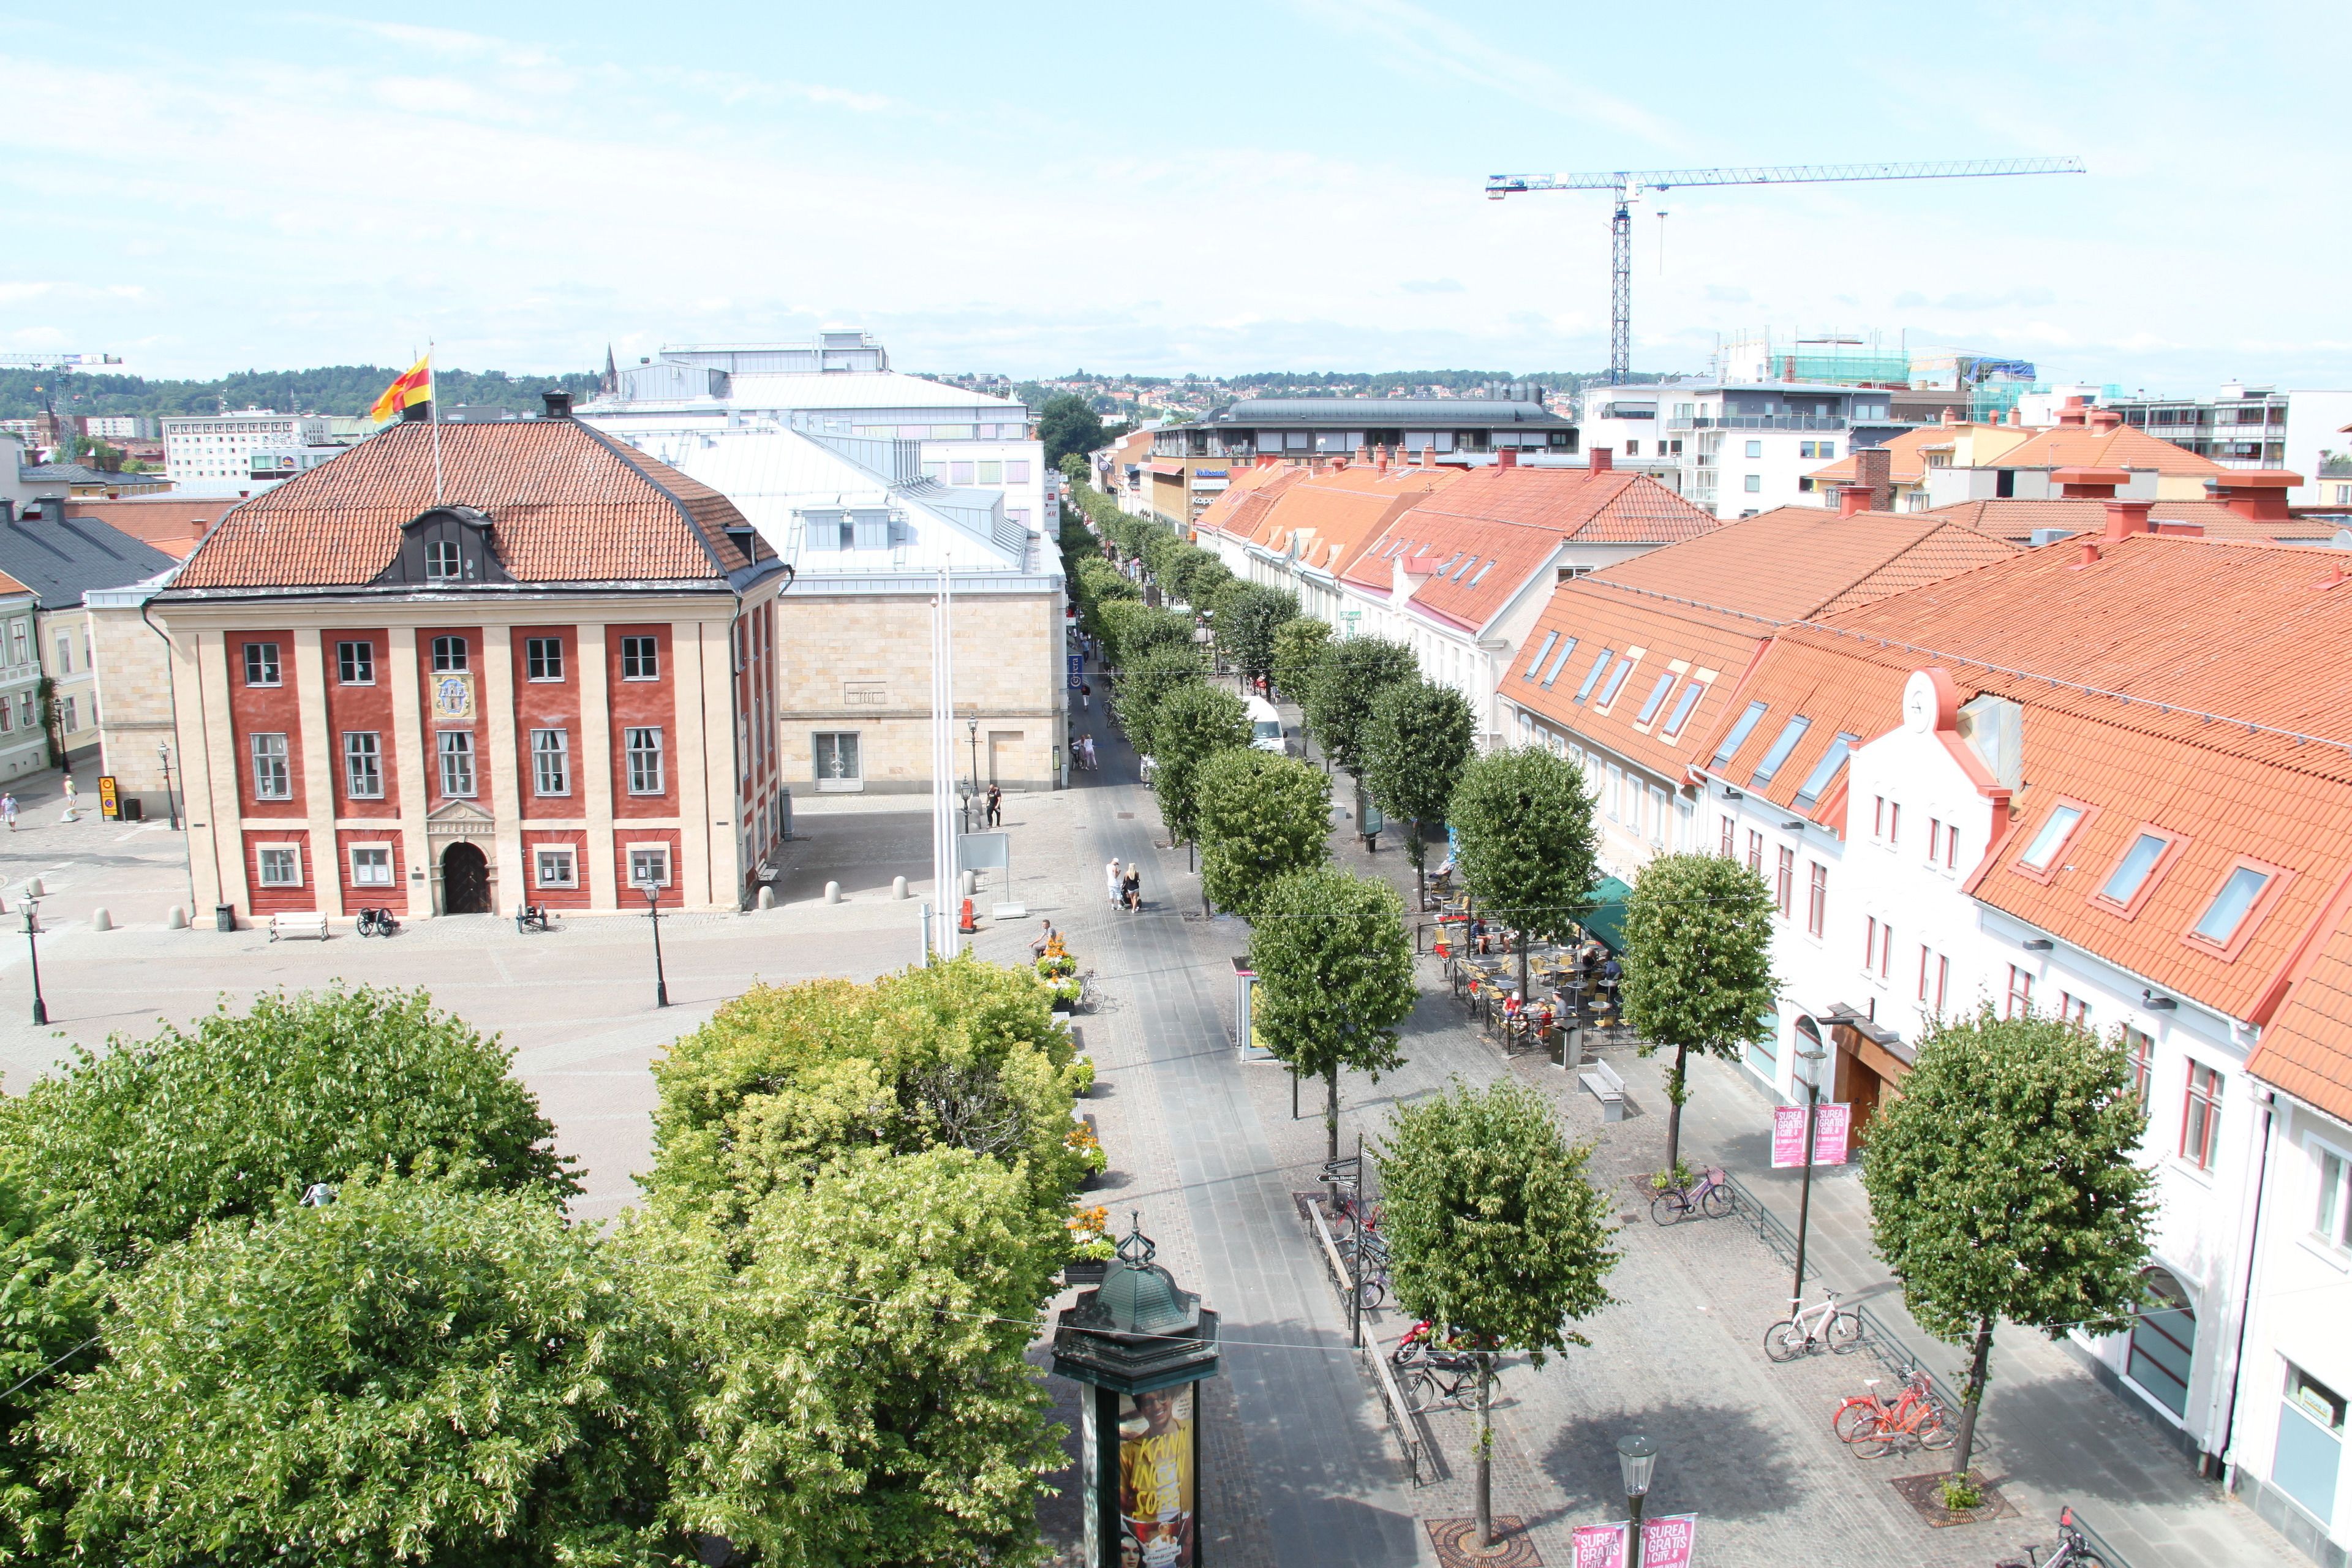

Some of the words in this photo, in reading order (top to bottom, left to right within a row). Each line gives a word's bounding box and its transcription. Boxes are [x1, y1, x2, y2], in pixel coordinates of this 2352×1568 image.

[1192, 496, 1215, 505] Kapp
[1777, 1120, 1803, 1129] GRATIS
[1819, 1118, 1844, 1127] GRATIS
[1649, 1524, 1686, 1539] SURFA
[1581, 1532, 1618, 1548] SURFA
[1648, 1536, 1687, 1553] GRATIS
[1580, 1543, 1620, 1561] GRATIS
[1651, 1550, 1671, 1563] CITY.
